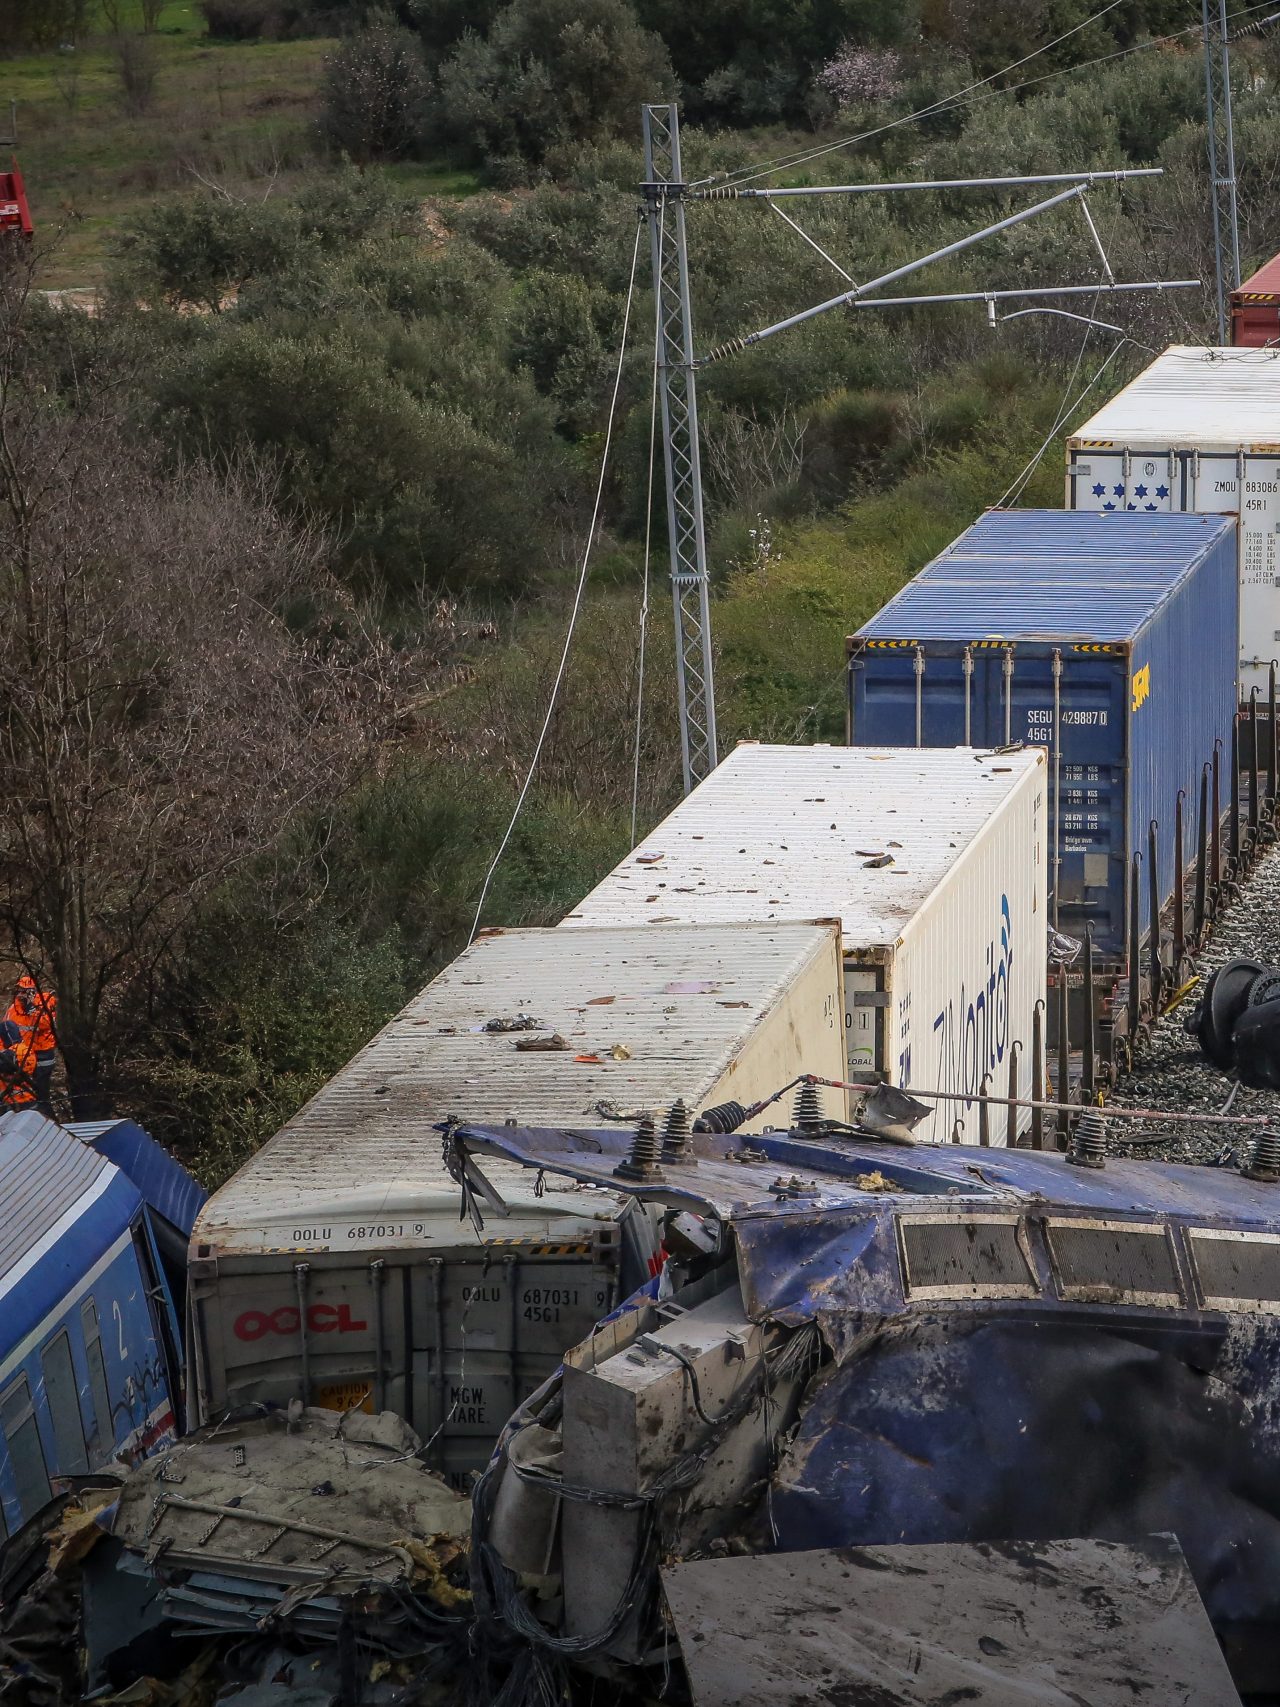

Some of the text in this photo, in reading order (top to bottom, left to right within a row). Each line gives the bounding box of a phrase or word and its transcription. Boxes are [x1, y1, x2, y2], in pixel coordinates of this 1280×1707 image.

[1214, 481, 1236, 492] ZMOU
[1245, 481, 1278, 493] 883086
[1245, 500, 1267, 511] 45R1
[1027, 710, 1053, 723] SEGU
[1061, 711, 1098, 724] 429887
[1027, 728, 1053, 740] 45G1
[293, 1224, 425, 1242] OOLU 687031 9
[462, 1287, 606, 1307] OOLU 687031 9
[233, 1303, 367, 1342] OOCL
[523, 1307, 561, 1323] 45G1
[113, 1299, 128, 1361] 2
[320, 1383, 369, 1398] CAUTION
[450, 1387, 487, 1405] MGW.
[450, 1407, 490, 1424] TARE.
[450, 1472, 472, 1489] NE
